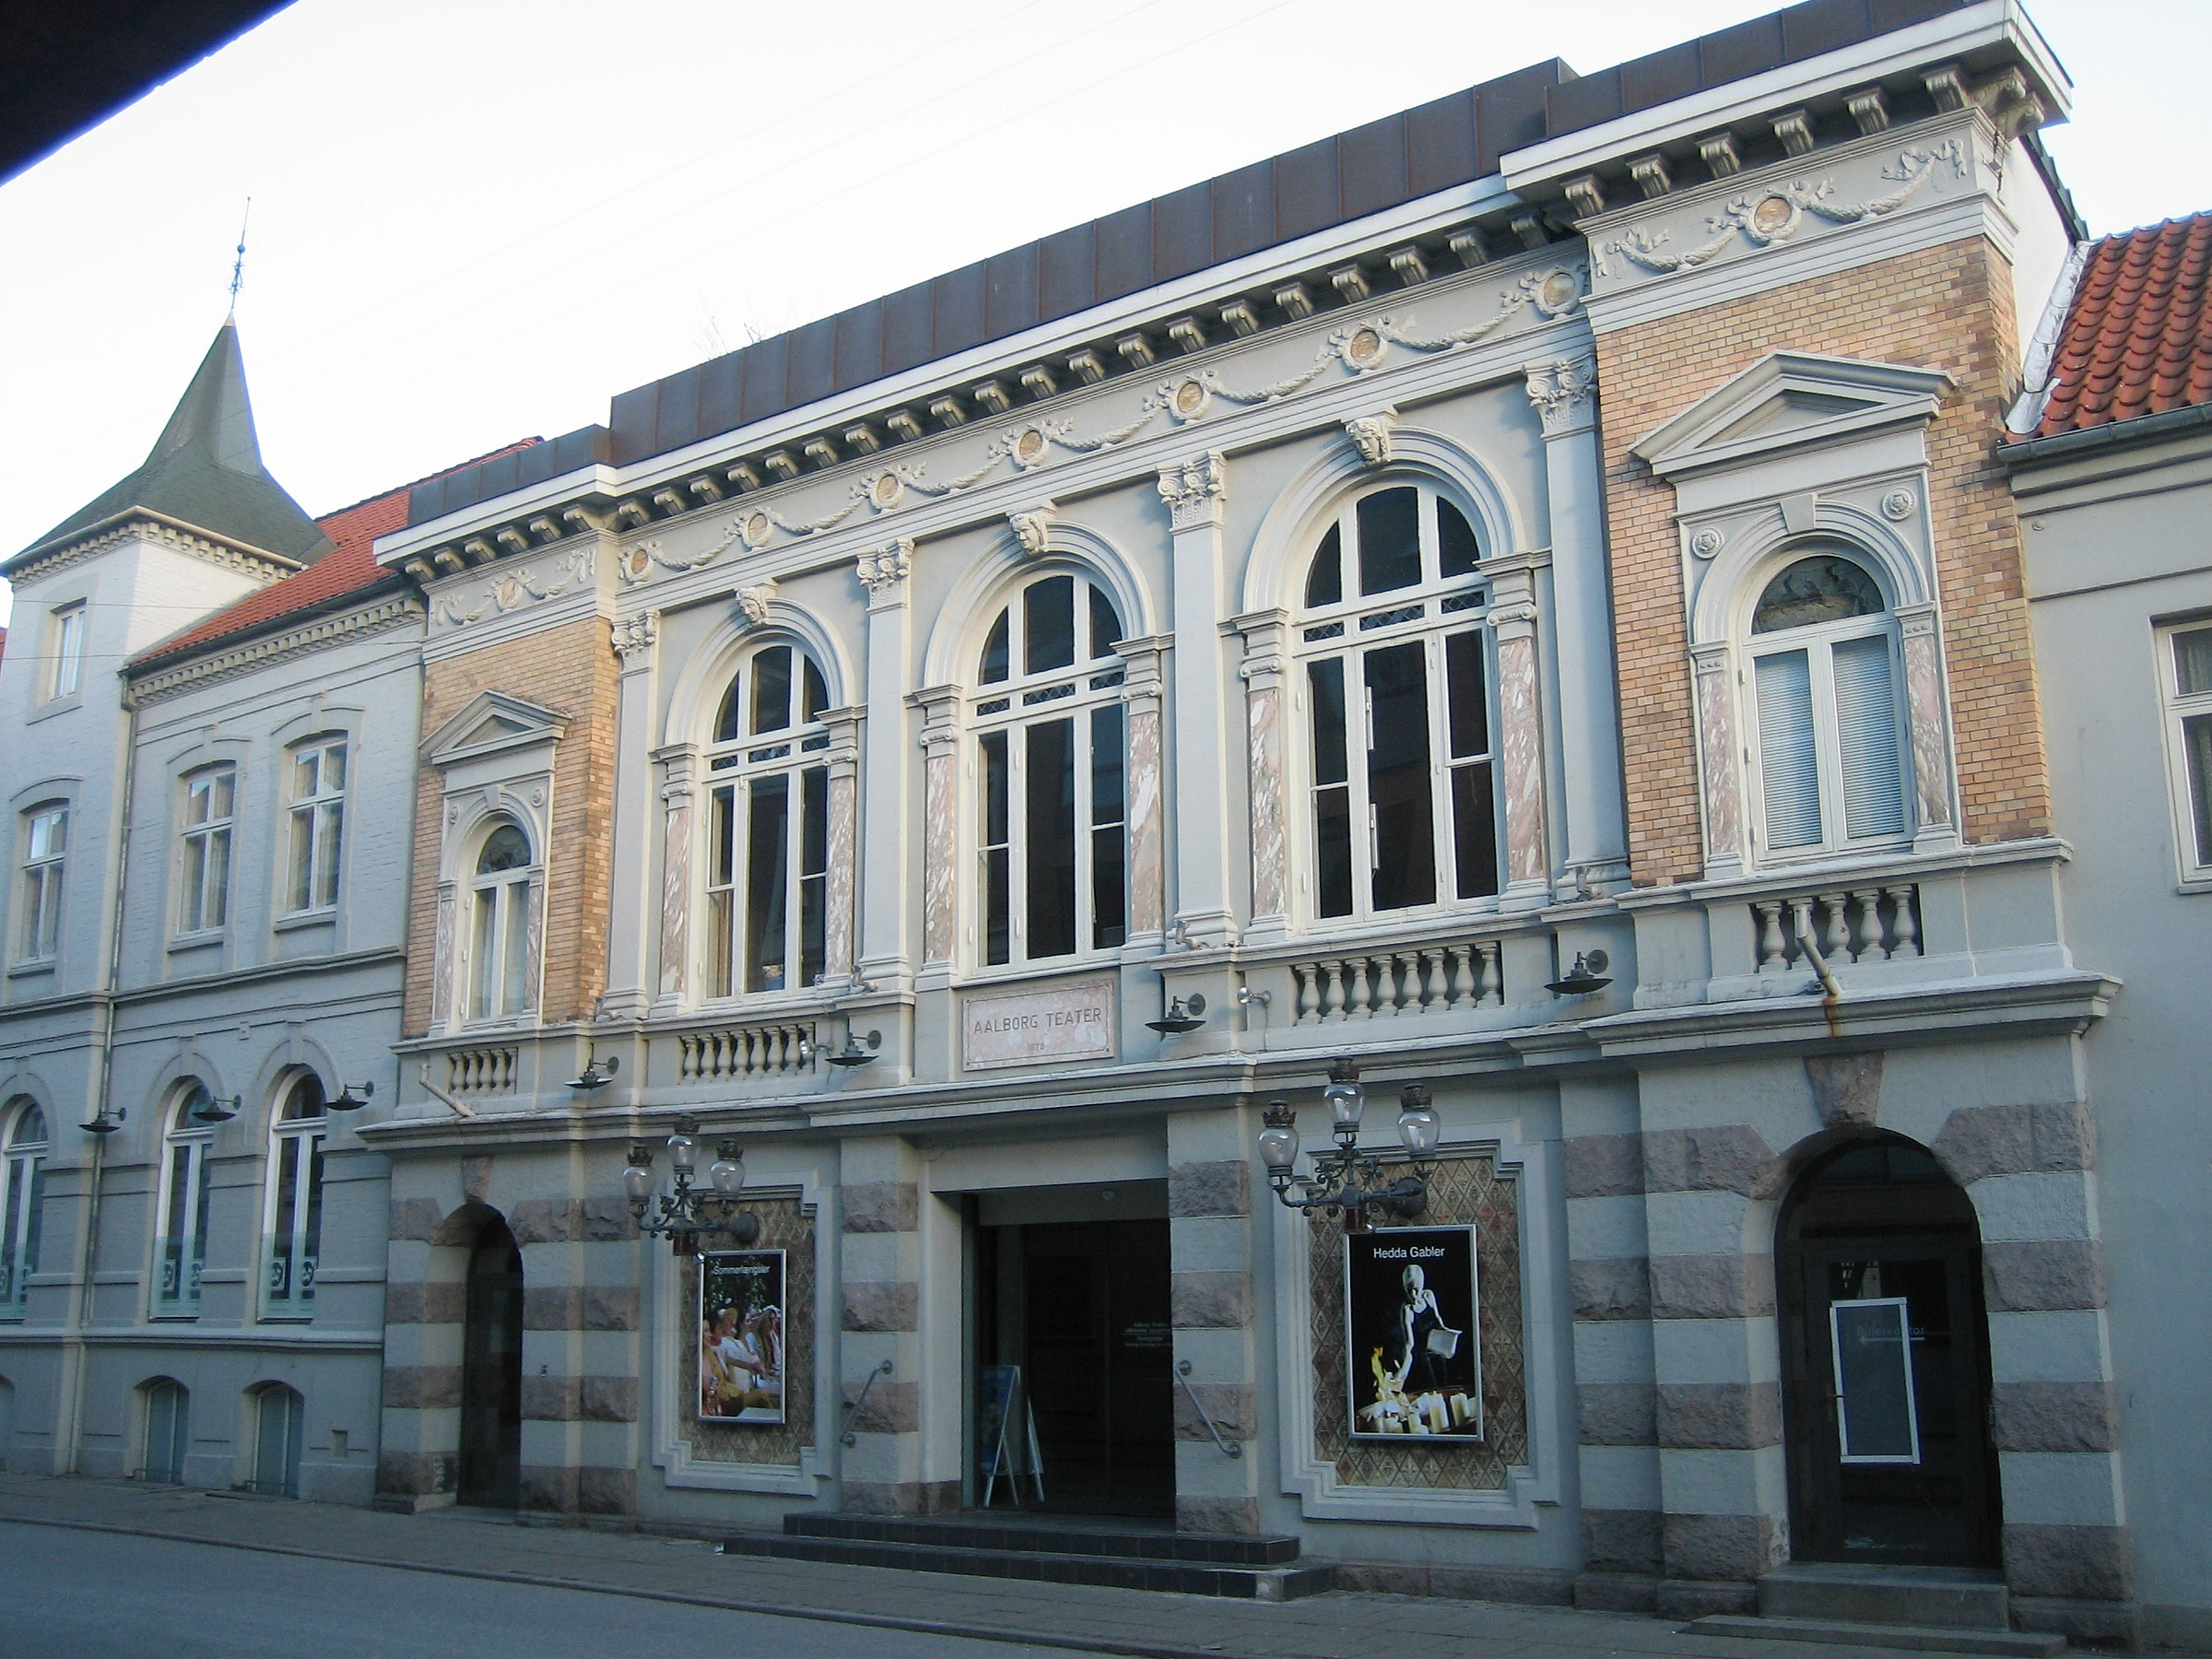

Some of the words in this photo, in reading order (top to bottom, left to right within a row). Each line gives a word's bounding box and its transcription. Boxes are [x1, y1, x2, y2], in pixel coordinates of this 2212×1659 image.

[973, 1015, 1038, 1035] AALBORG
[1046, 1007, 1101, 1027] TEATER
[1373, 1247, 1407, 1259] Hedda
[1409, 1245, 1445, 1258] Gabler
[1856, 1325, 1925, 1335] Billetkotor
